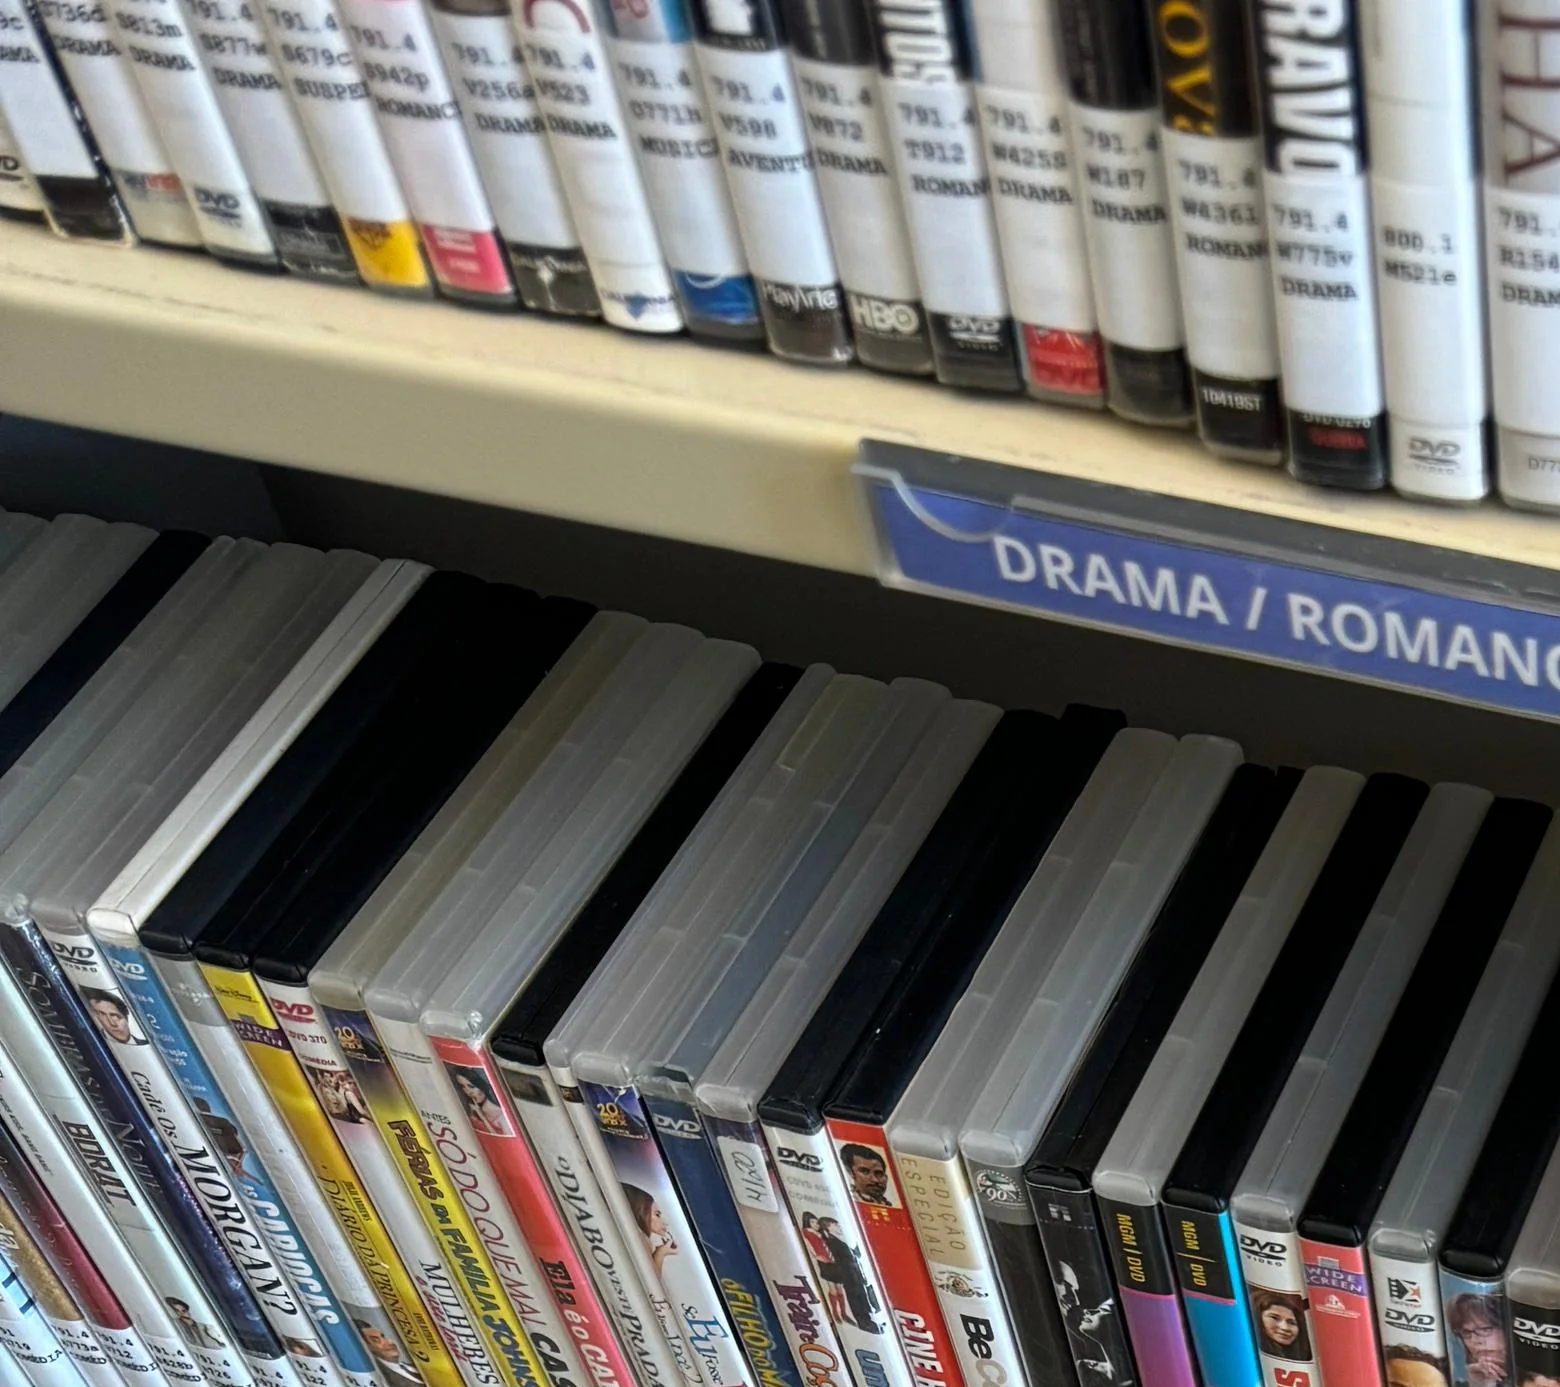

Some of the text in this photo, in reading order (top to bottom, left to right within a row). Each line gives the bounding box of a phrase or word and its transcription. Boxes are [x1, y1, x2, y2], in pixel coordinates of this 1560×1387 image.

[214, 67, 282, 90] DRAMA
[475, 112, 546, 134] DRAMA
[546, 113, 617, 138] DRAMA
[818, 146, 887, 173] DRAMA
[1000, 178, 1072, 205] DRAMA
[1092, 199, 1167, 223] DRAMA
[1281, 275, 1357, 302] DRAMA
[854, 300, 920, 334] HBO
[1409, 437, 1461, 457] DVD
[995, 535, 1228, 625] DRAMA
[1246, 588, 1263, 630] /
[63, 1121, 136, 1206] BORAT
[387, 1119, 444, 1201] FÉRIAS
[428, 1121, 547, 1326] SÓ DO QUE MAL
[902, 1158, 944, 1256] ESPECIAL
[930, 1174, 966, 1251] EDIÇÃO
[171, 1146, 298, 1316] MORGAN?
[1116, 1213, 1145, 1283] MGM DVD
[1241, 1235, 1287, 1254] DVD
[255, 1202, 339, 1324] CARIOCAS
[1181, 1220, 1207, 1287] MGM DVD
[1306, 1265, 1356, 1283] WIDE
[419, 1260, 500, 1385] MULHERES
[961, 1314, 994, 1360] Be
[1385, 1309, 1435, 1326] DVD
[894, 1309, 943, 1373] CINE
[1519, 1337, 1559, 1350] VIDEO
